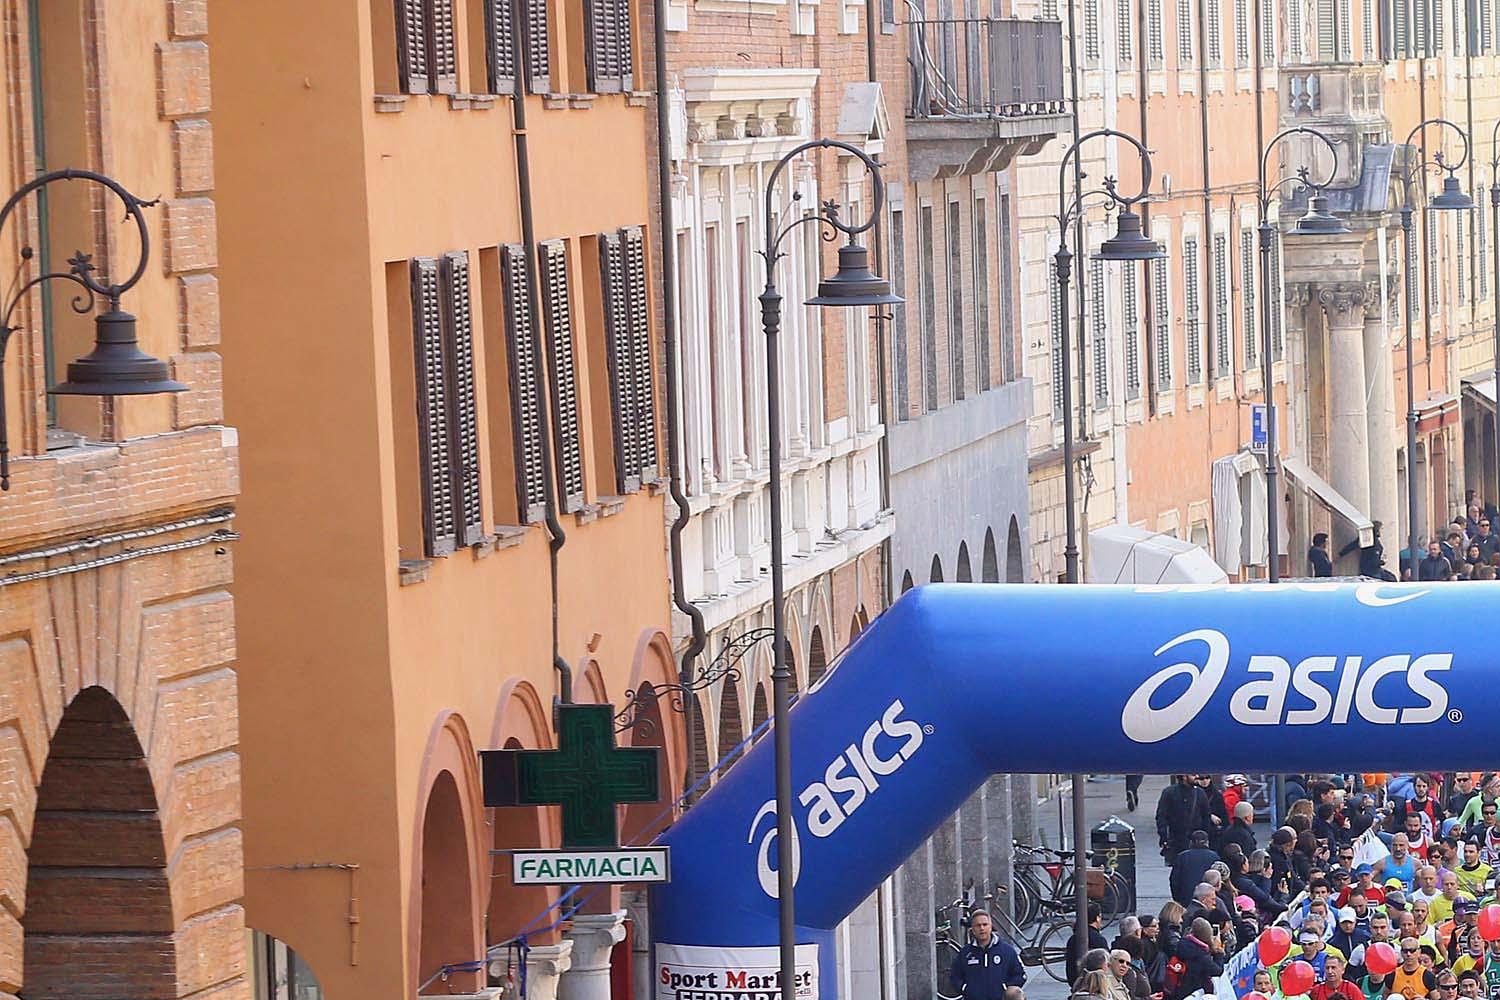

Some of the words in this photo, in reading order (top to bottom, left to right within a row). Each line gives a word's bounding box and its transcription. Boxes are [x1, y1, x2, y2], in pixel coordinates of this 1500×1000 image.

[1229, 653, 1454, 727] asics
[799, 698, 924, 838] asics
[520, 857, 658, 878] FARMACIA
[661, 966, 718, 990] Sport
